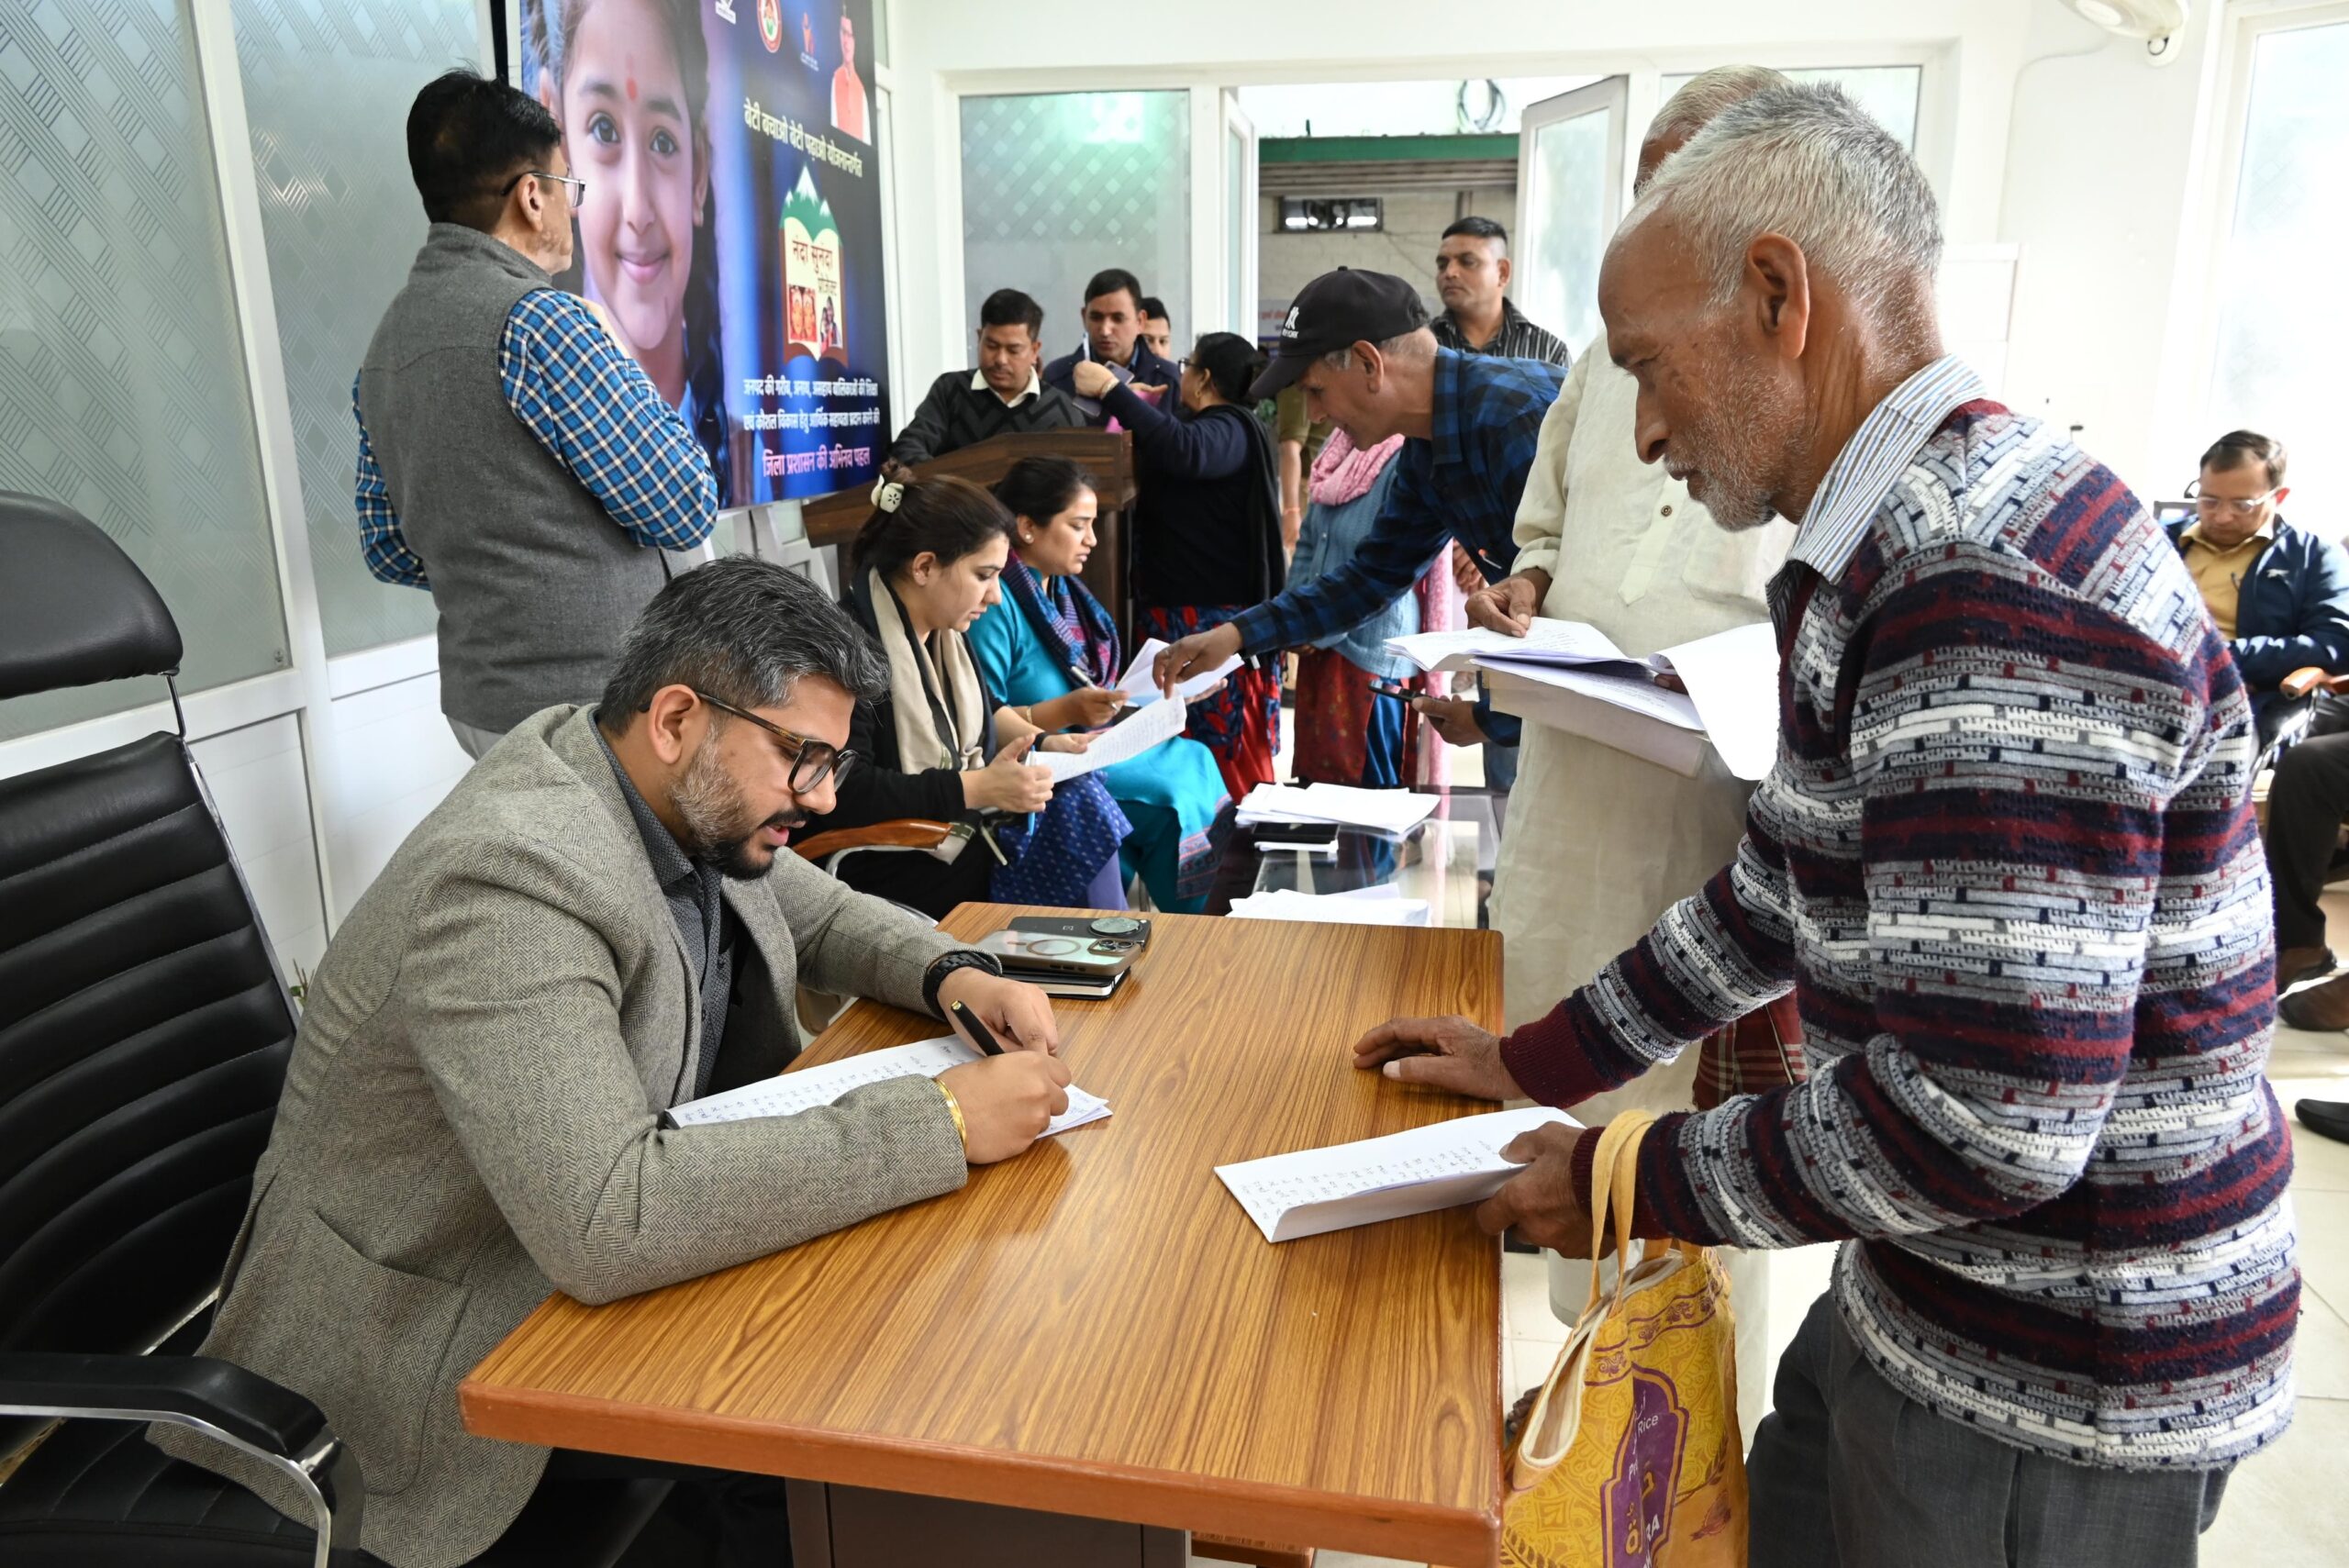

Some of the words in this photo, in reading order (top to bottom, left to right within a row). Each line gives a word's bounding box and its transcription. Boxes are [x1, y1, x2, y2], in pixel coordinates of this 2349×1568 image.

[743, 96, 761, 132] बेटी
[761, 112, 789, 145] बचाओ
[789, 119, 805, 151] बेटी
[805, 133, 827, 161] पढ़ाओ
[764, 374, 774, 395] की
[858, 377, 865, 396] की
[874, 406, 881, 425] की
[763, 449, 785, 477] जिला
[785, 451, 816, 474] प्रशासन
[816, 444, 828, 470] की
[829, 443, 853, 470] अभिनव
[853, 447, 871, 467] पहल
[1638, 1415, 1659, 1438] Rice
